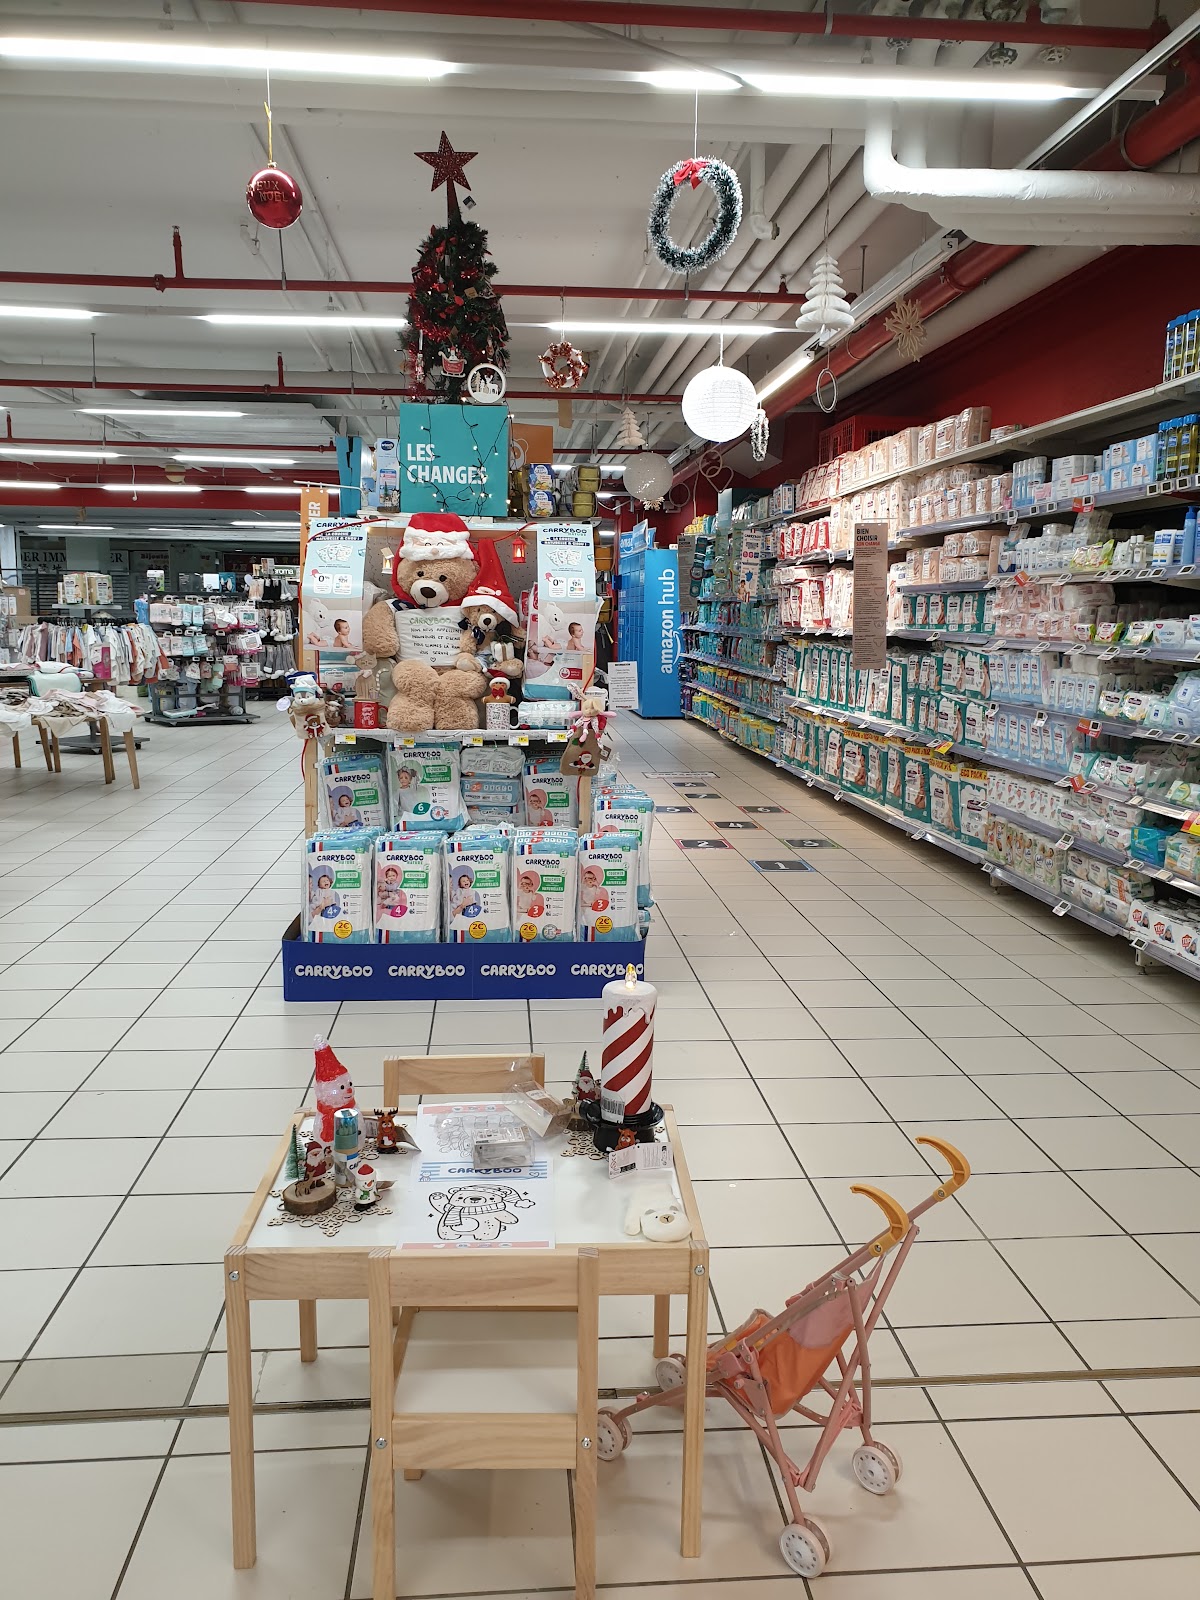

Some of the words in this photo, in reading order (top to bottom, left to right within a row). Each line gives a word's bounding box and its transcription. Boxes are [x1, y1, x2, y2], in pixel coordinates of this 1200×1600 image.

[406, 443, 436, 462] LES
[406, 464, 488, 485] CHANGES
[657, 568, 675, 605] hub
[409, 616, 452, 626] CARRYBOO
[660, 609, 675, 675] amazon
[960, 768, 970, 778] ECO
[970, 769, 983, 780] PACK
[417, 803, 424, 811] 6
[605, 813, 639, 821] CARRYBOO
[697, 840, 712, 848] 2
[316, 854, 356, 862] CARRYBOO
[386, 854, 424, 862] CARRYBOO
[456, 854, 494, 862] CARRYBOO
[588, 853, 623, 861] CARRYBOO
[597, 900, 603, 908] 3
[327, 908, 338, 916] 4+
[395, 906, 401, 914] 4
[533, 906, 539, 914] 3
[294, 963, 373, 979] CARRYBOO
[388, 963, 466, 979] CARRYBOO
[480, 963, 557, 978] CARRYBOO
[570, 963, 644, 978] CARRYBO
